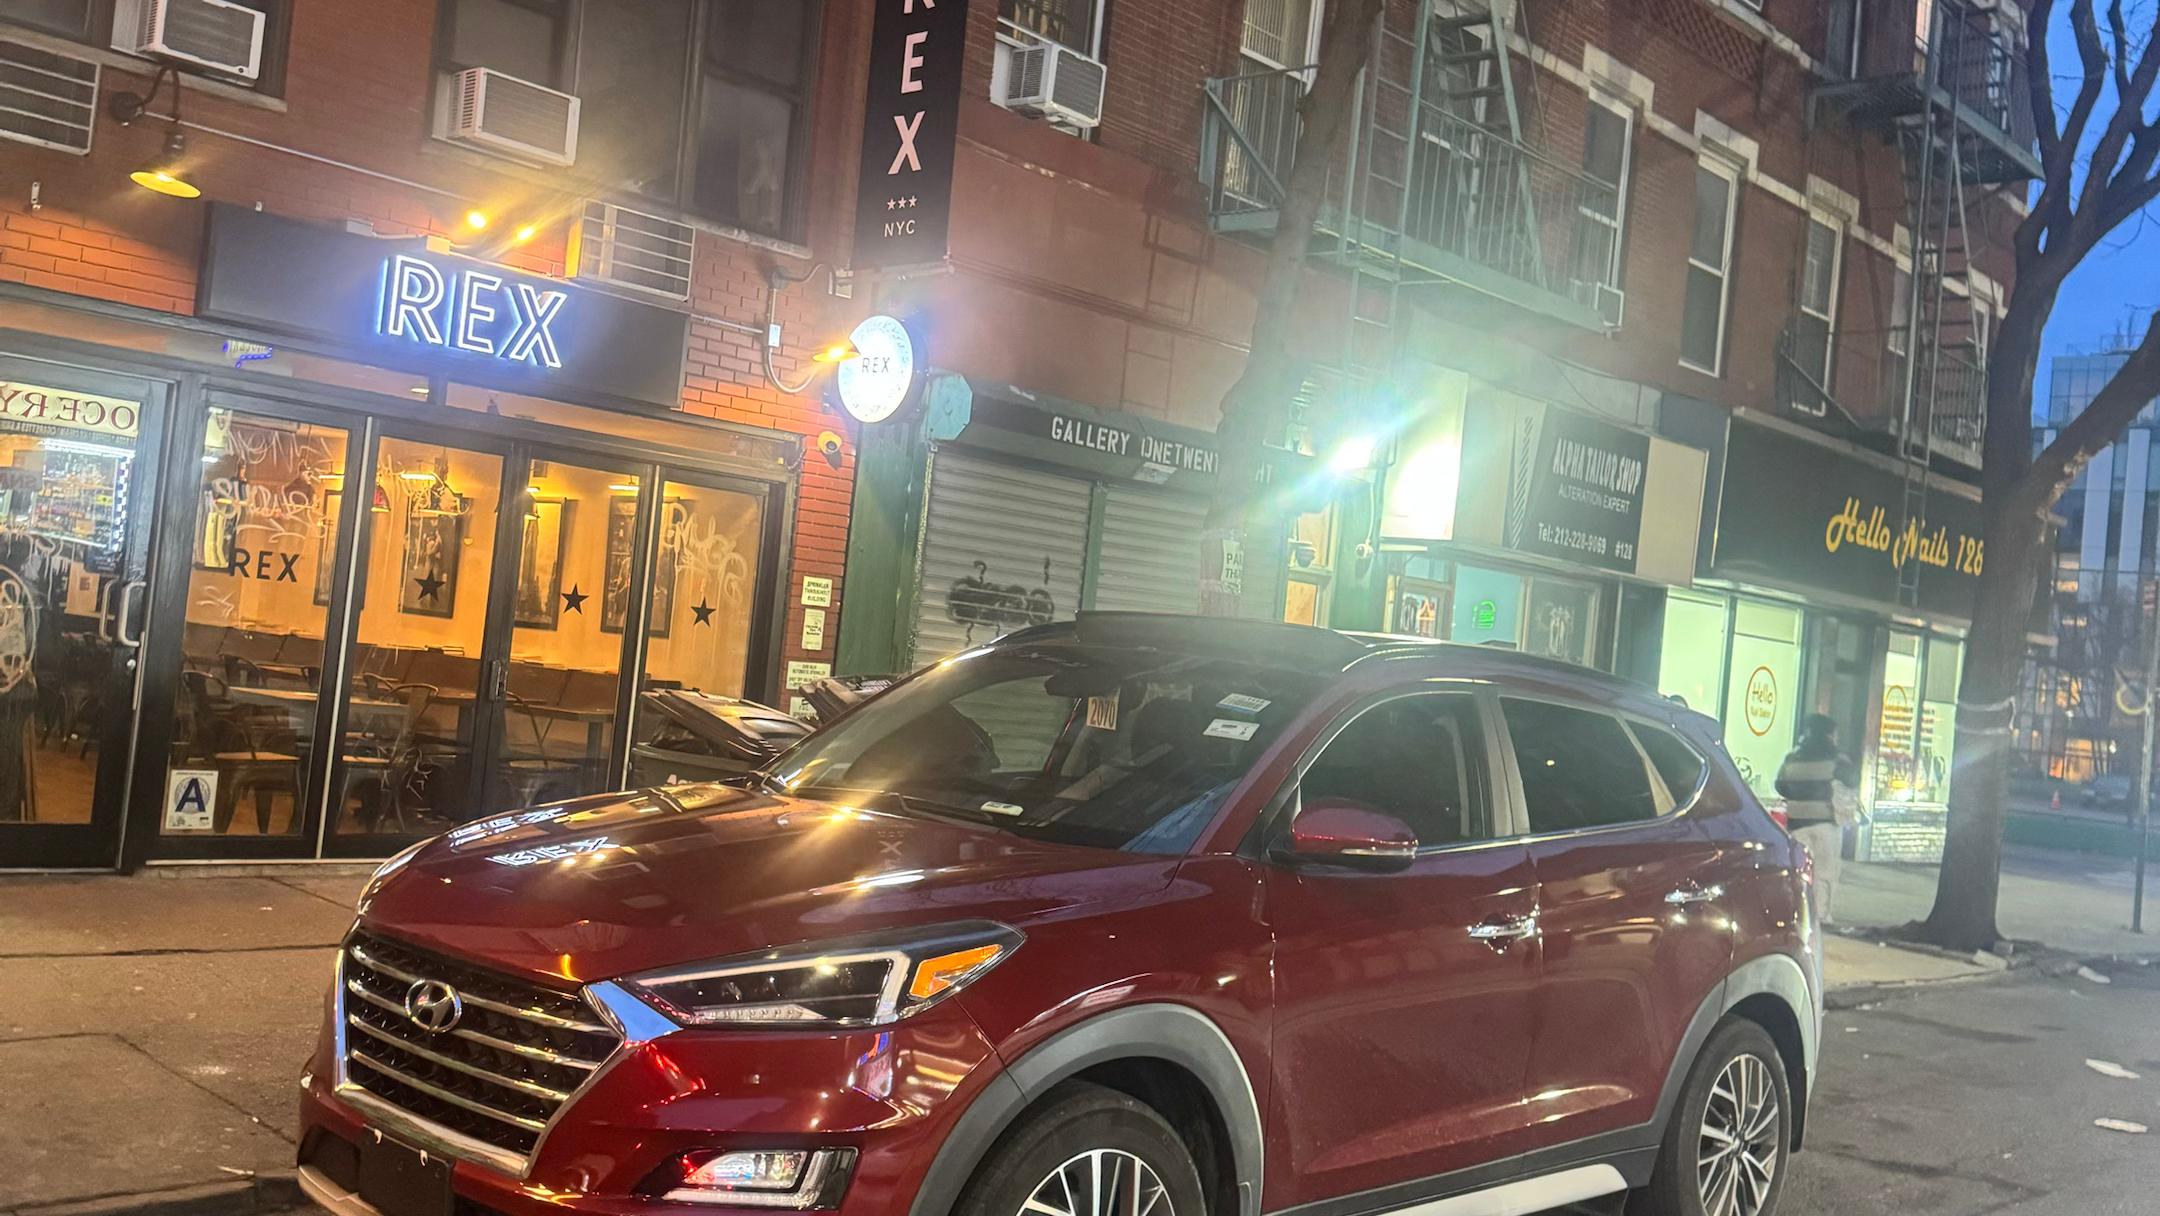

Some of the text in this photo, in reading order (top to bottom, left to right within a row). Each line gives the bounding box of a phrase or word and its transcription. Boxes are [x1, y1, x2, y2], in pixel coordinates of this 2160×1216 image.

[887, 0, 937, 175] EX
[884, 219, 916, 238] NYC
[388, 254, 568, 368] REX
[862, 356, 890, 373] REX
[1051, 415, 1131, 456] GALLERY
[1552, 437, 1642, 496] ALPHA TAILOR SHOP
[1558, 483, 1630, 514] ALTERATION EXPERT
[1538, 522, 1553, 545] Tel:
[1615, 540, 1634, 561] #128
[1825, 496, 1984, 577] Hello Nails 128
[227, 548, 300, 583] REX
[175, 777, 206, 812] A
